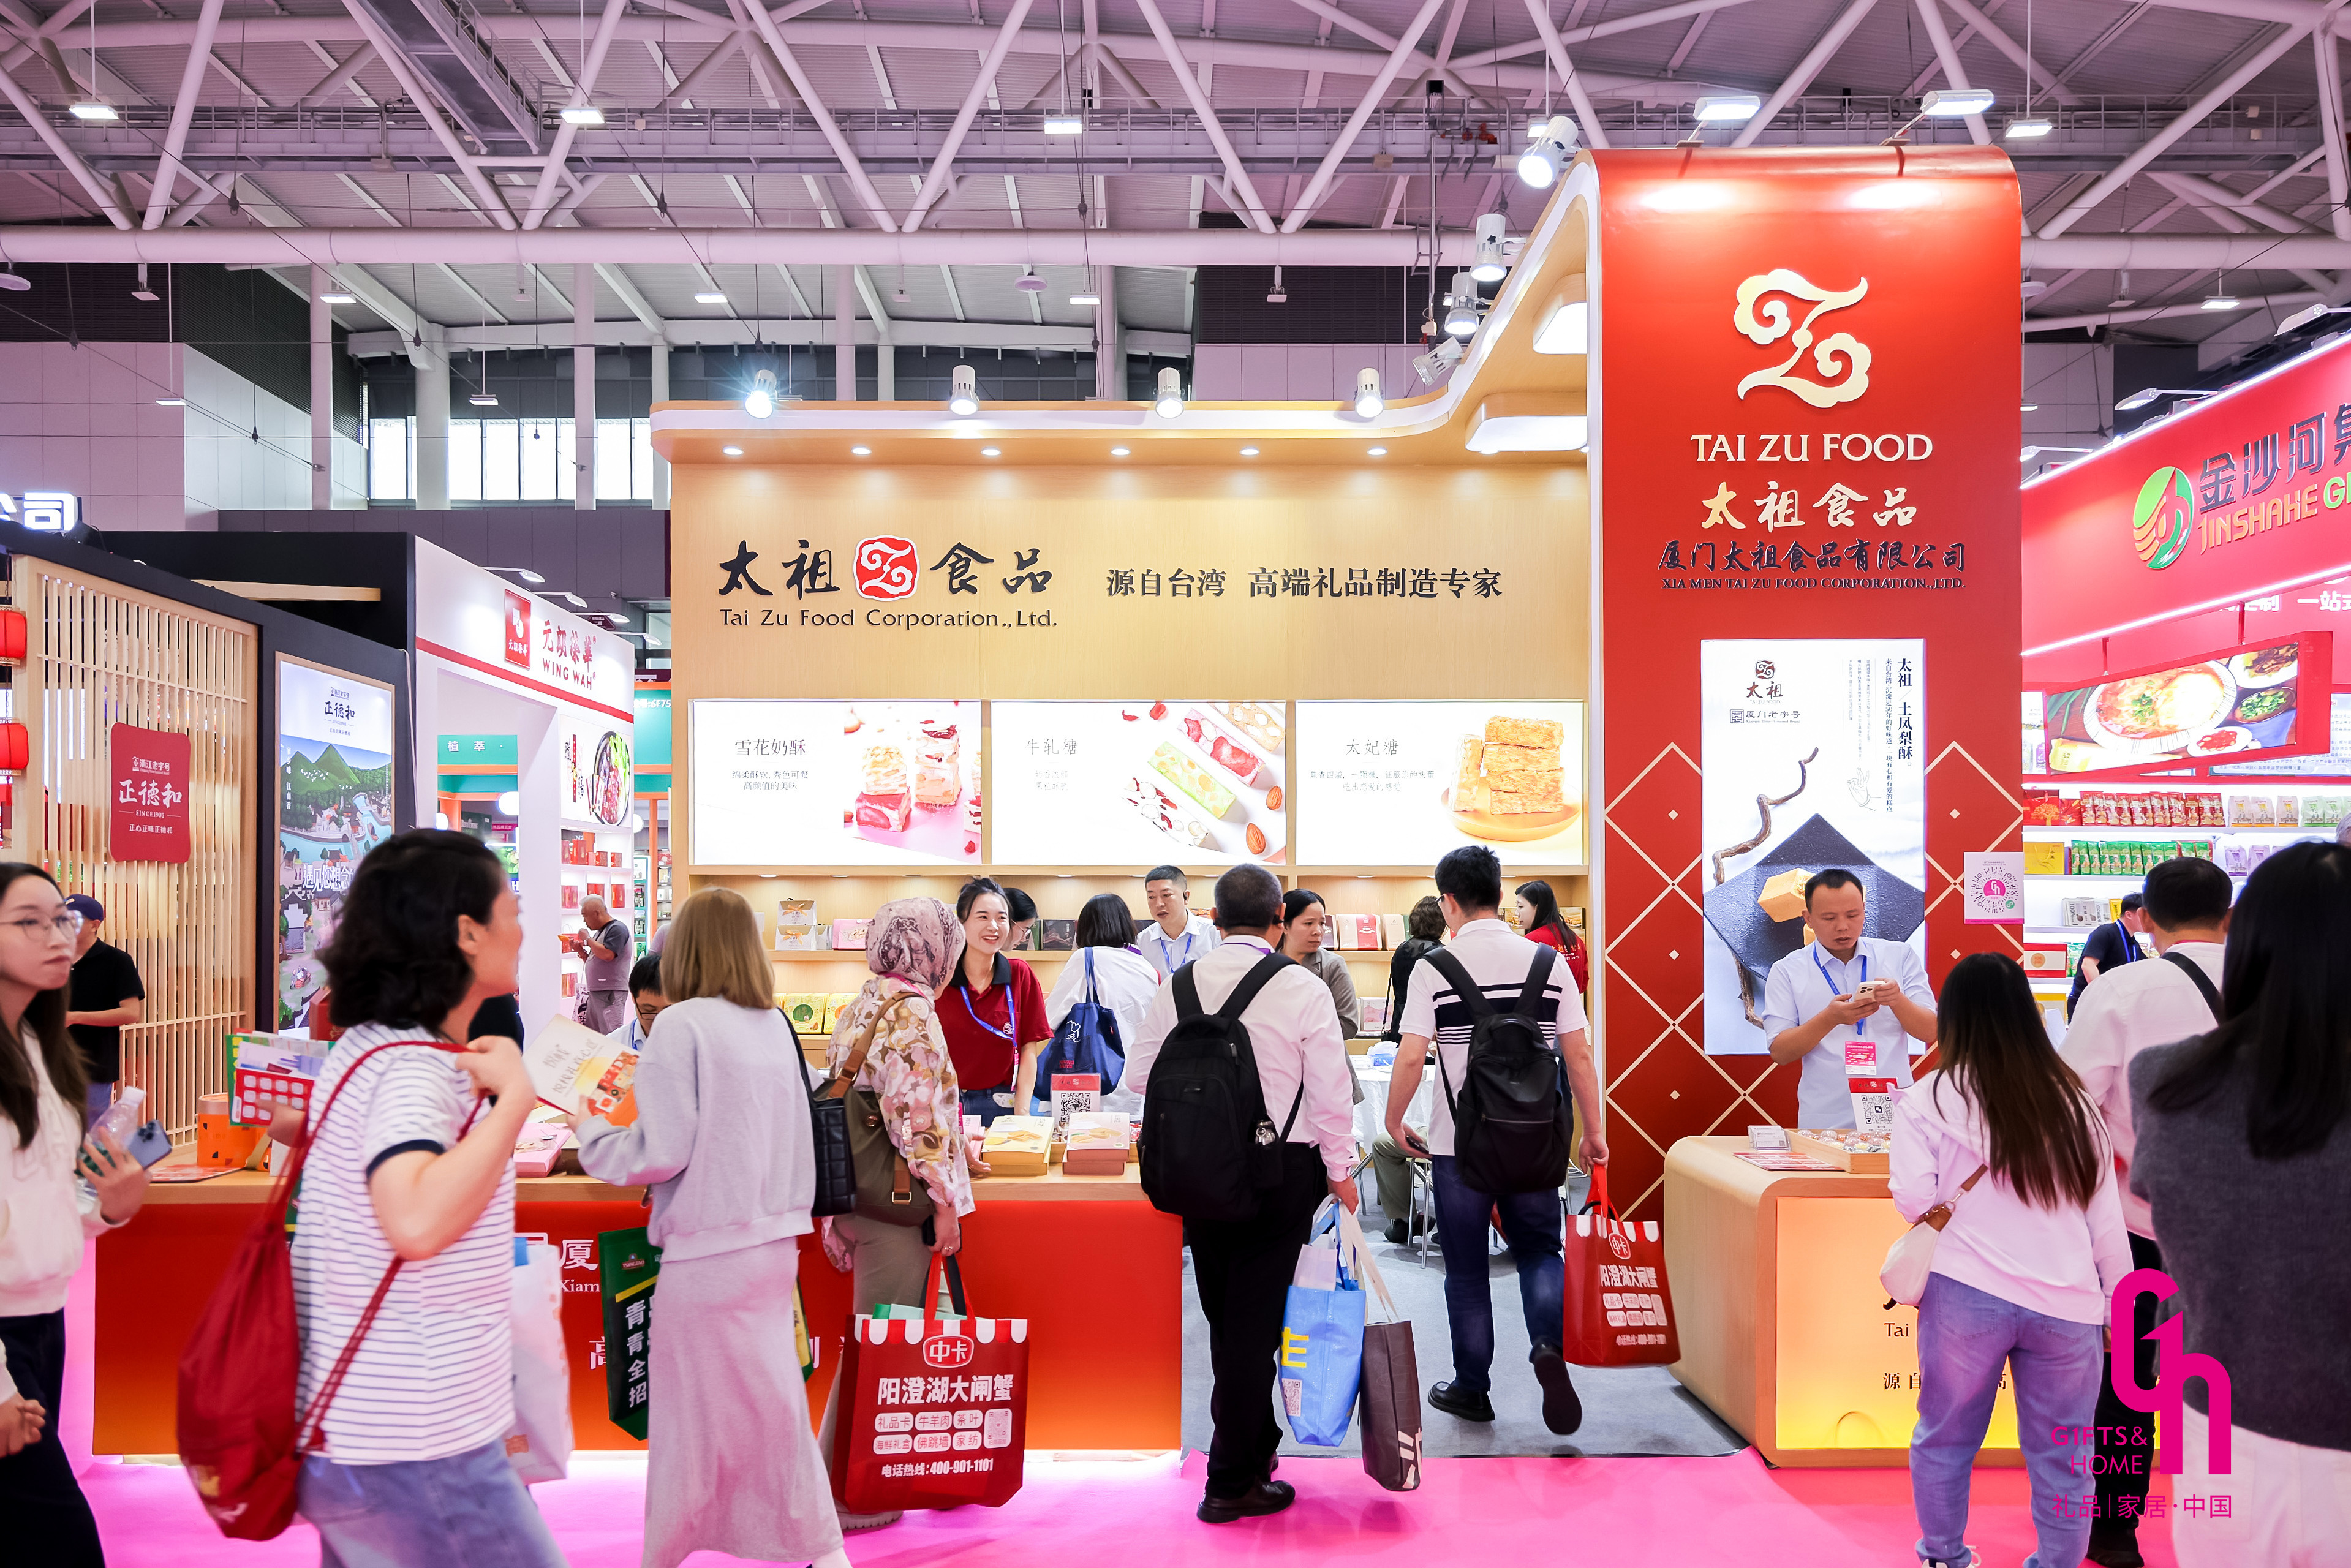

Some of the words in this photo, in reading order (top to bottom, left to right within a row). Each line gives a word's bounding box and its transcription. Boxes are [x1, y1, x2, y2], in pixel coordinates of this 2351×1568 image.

[1691, 434, 1745, 462] TAI
[1757, 434, 1809, 462] ZU
[1823, 434, 1933, 462] FOOD
[1701, 481, 1917, 533] 太祖食品
[2197, 484, 2318, 556] JINSHAHE
[1658, 538, 1966, 573] 厦门太祖食品有限公司
[1106, 568, 1226, 598] 源自台湾
[1248, 567, 1503, 599] 高端礼品制造专家
[1662, 578, 1686, 589] XIA
[1690, 578, 1722, 589] MEN
[1726, 578, 1749, 589] TAI
[1752, 578, 1771, 589] ZU
[1775, 578, 1817, 589] FOOD
[720, 609, 749, 627] Tai
[761, 610, 788, 627] Zu
[801, 609, 855, 627] Food
[542, 657, 569, 680] WING
[573, 669, 592, 690] WAH
[1746, 680, 1784, 699] 太祖
[325, 701, 355, 720] 正德和
[734, 739, 806, 756] 雪花奶酥
[1025, 738, 1078, 755] 牛轧糖
[1346, 738, 1399, 756] 太妃糖
[119, 778, 183, 809] 正德和
[1884, 1322, 1909, 1337] Tai
[929, 1340, 968, 1363] 中卡
[877, 1374, 1014, 1406] 阳澄湖大闸蟹
[878, 1415, 913, 1429] 礼品卡
[918, 1411, 950, 1427] 牛羊肉
[875, 1438, 911, 1451] 海鲜礼盒
[917, 1435, 949, 1450] 佛跳墙
